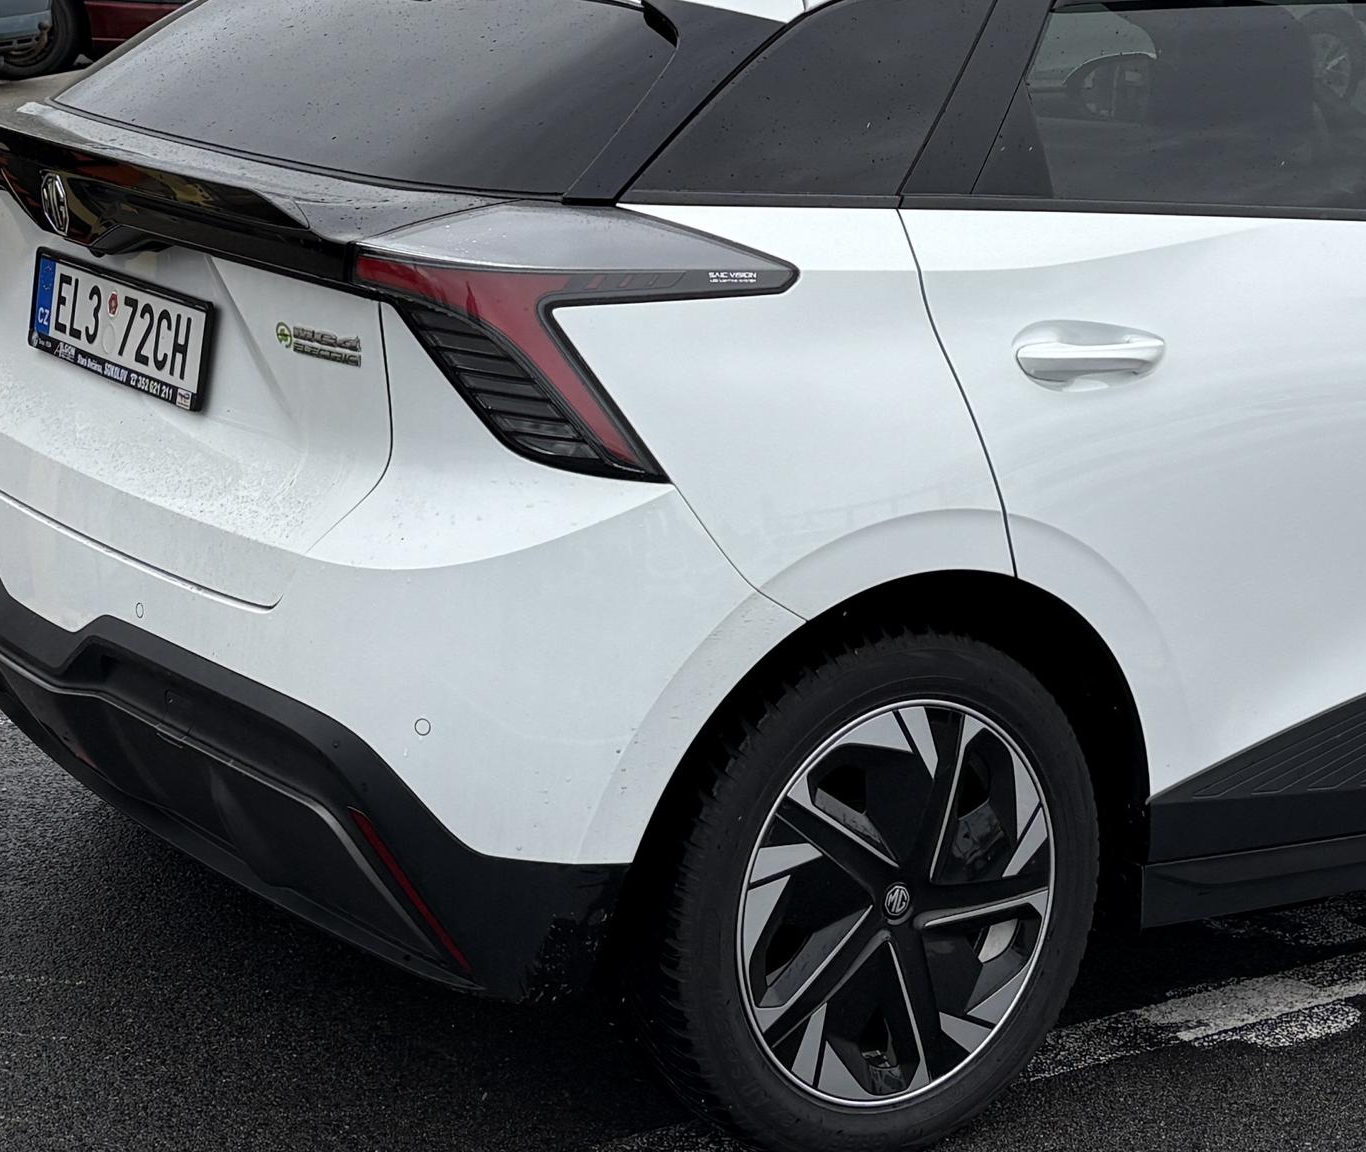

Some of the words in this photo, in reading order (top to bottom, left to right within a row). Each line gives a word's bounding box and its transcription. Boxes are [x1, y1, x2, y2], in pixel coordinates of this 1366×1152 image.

[37, 306, 50, 327] CZ
[54, 273, 102, 344] EL3
[118, 295, 192, 381] 72CH
[137, 375, 149, 392] 352
[149, 379, 161, 396] 621
[160, 384, 173, 401] 211
